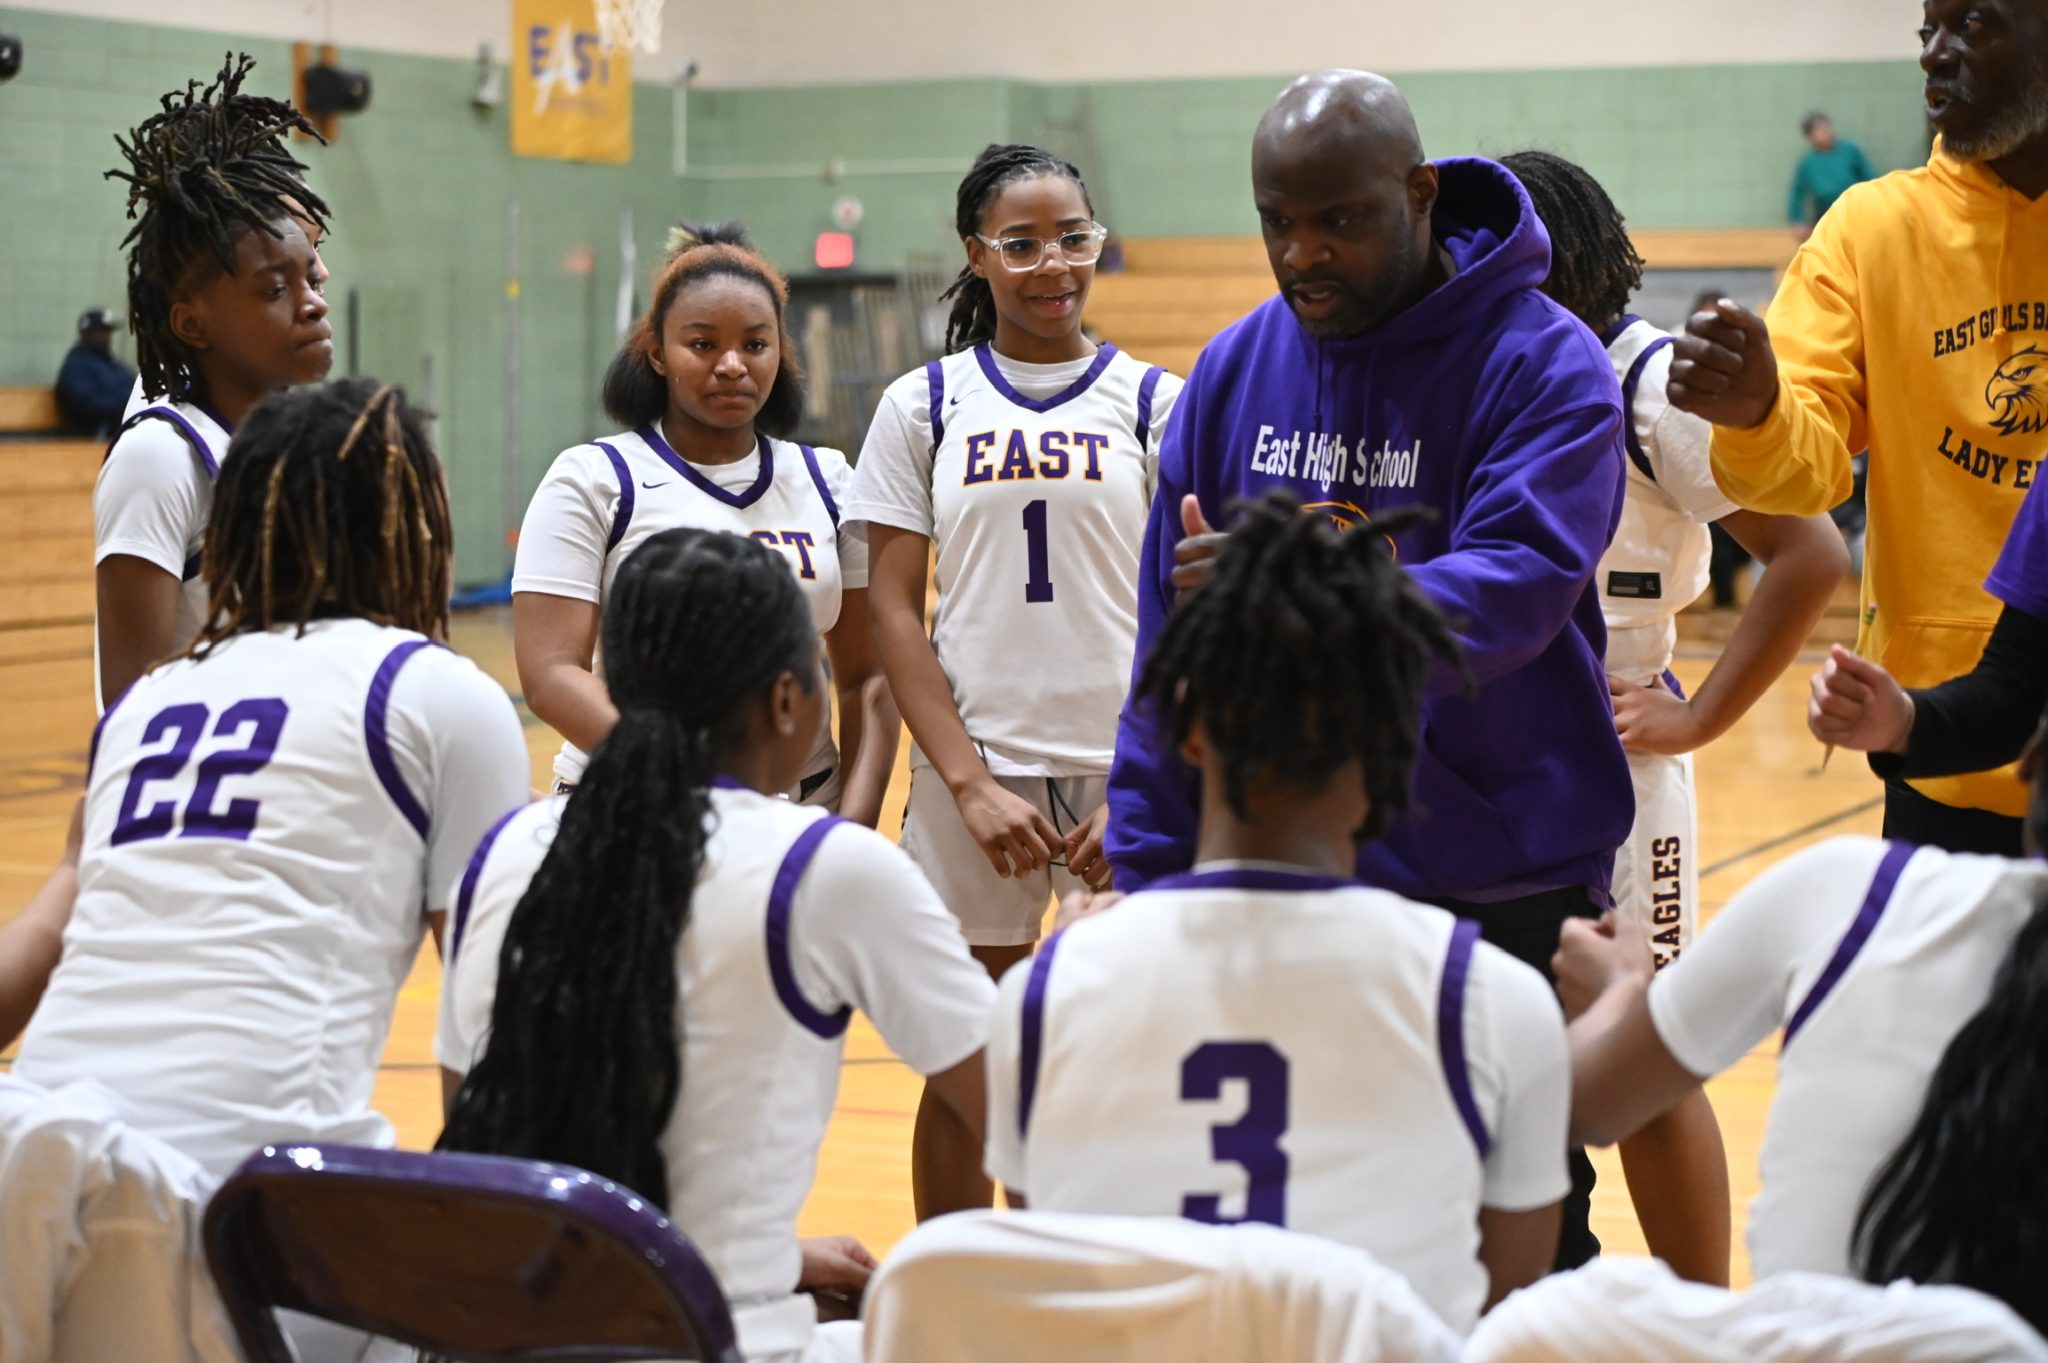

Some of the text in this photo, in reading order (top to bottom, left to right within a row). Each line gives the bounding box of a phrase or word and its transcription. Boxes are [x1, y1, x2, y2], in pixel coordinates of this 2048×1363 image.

[1933, 316, 1975, 358] EAST
[963, 428, 1110, 487] EAST
[1250, 424, 1421, 493] East High School
[1937, 425, 2043, 489] LADY E
[1022, 499, 1054, 603] 1
[110, 697, 290, 848] 22
[1180, 1040, 1290, 1228] 3
